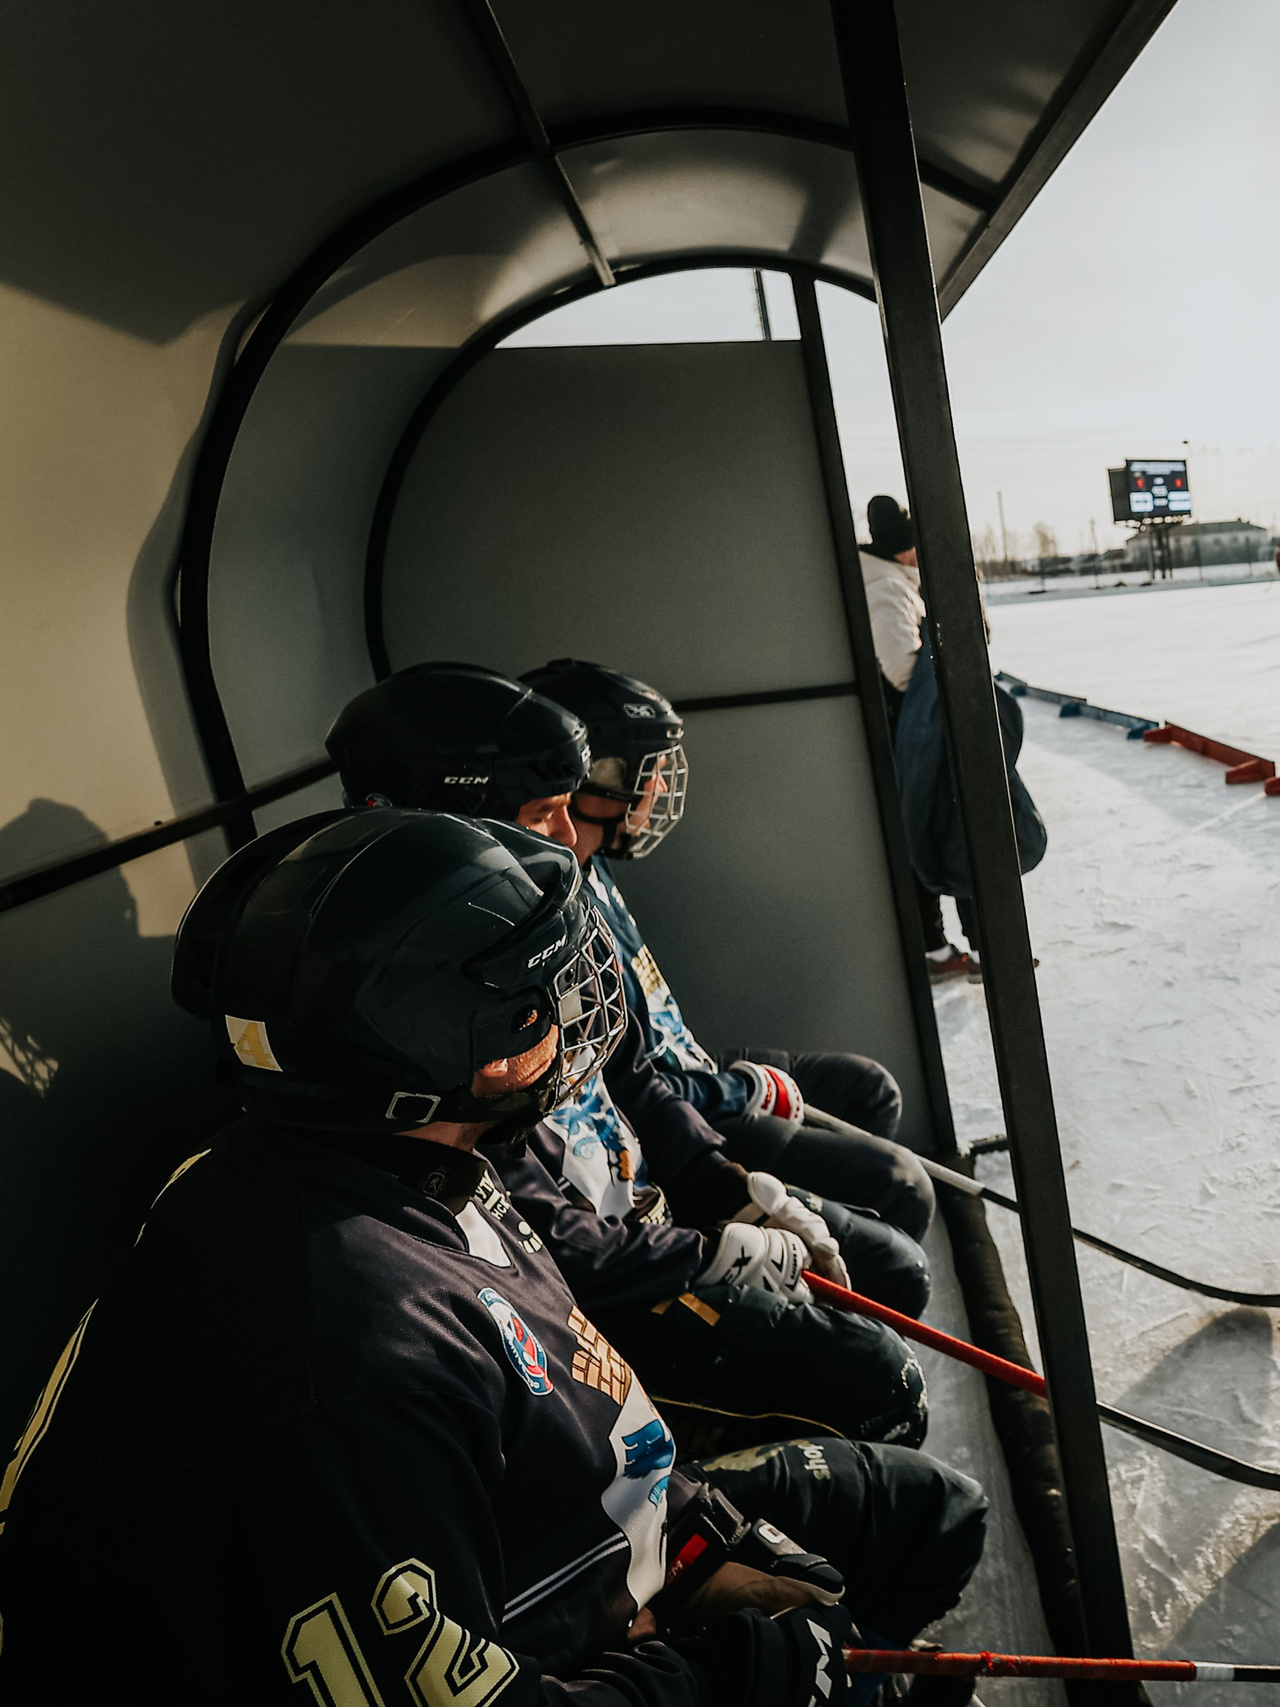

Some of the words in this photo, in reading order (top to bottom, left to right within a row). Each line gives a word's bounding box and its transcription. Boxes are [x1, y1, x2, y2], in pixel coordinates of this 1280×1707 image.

[444, 776, 489, 785] CCM
[527, 934, 567, 969] CCM
[279, 1557, 521, 1707] 12
